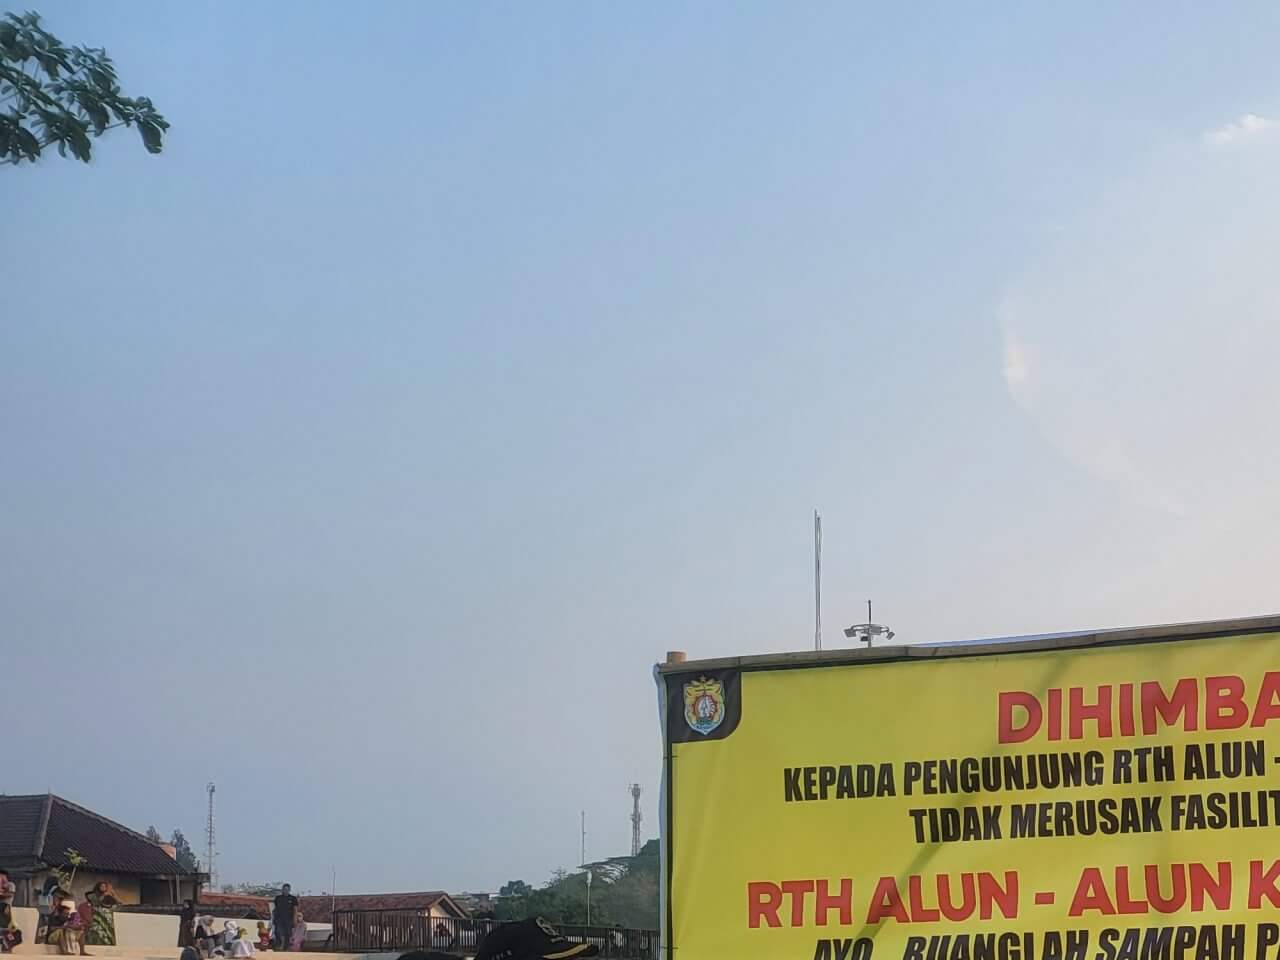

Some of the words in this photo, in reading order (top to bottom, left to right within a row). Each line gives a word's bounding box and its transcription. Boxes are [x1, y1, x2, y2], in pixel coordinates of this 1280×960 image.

[784, 762, 896, 802] KEPADA
[904, 751, 1104, 795] PENGUNJUNG
[1113, 746, 1174, 784] RTH
[1185, 740, 1265, 780] ALUN
[910, 806, 1002, 844] TIDAK
[1010, 797, 1162, 838] MERUSAK
[747, 878, 853, 929] RTH
[866, 870, 1019, 925] ALUN
[1068, 861, 1233, 918] ALUN
